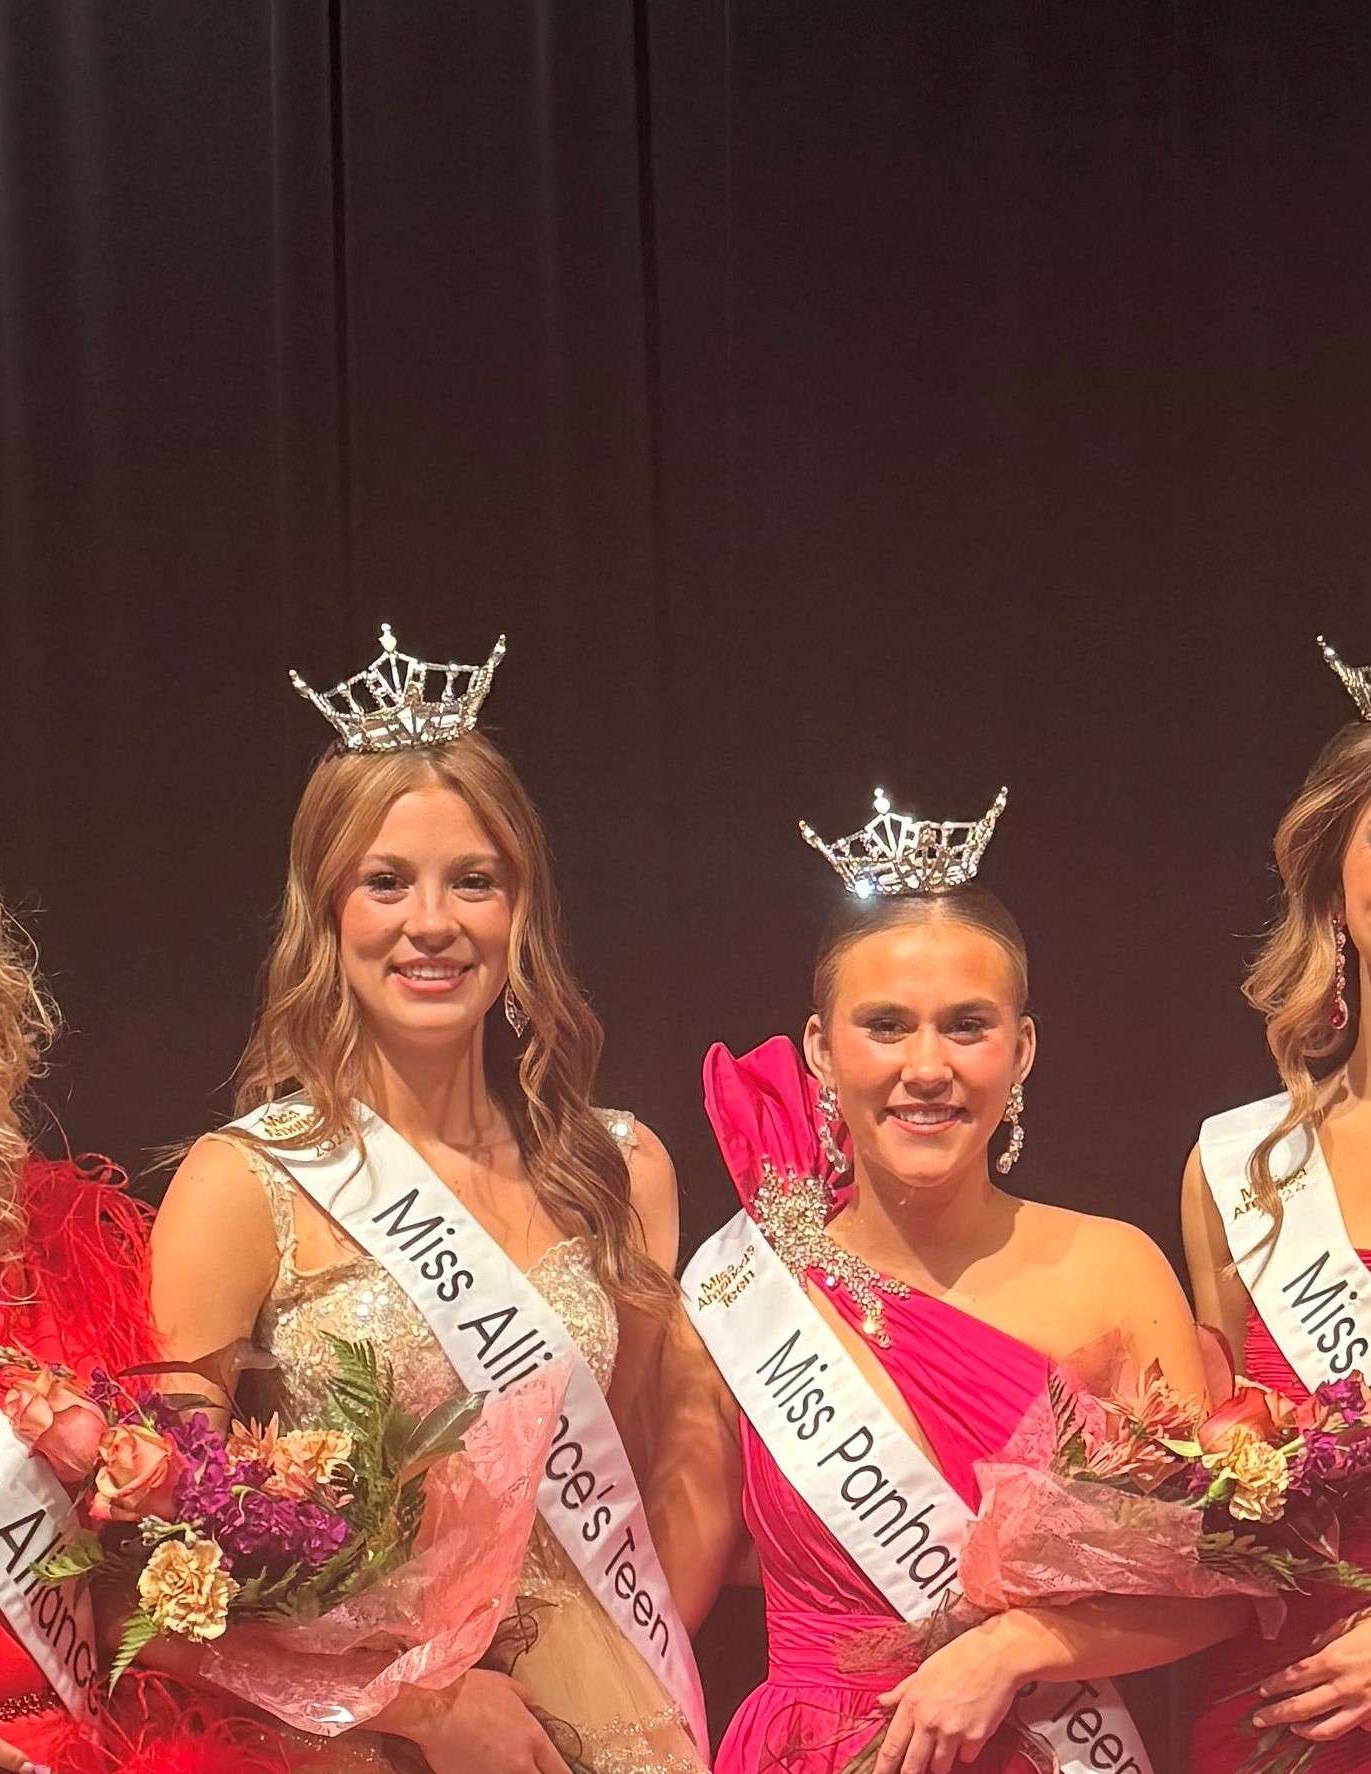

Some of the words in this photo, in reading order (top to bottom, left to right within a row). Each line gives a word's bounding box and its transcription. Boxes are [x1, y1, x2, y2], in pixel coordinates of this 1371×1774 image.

[718, 1270, 755, 1308] Teen
[1281, 1251, 1368, 1374] Miss
[371, 1189, 474, 1302] Miss
[604, 1527, 672, 1660] Teen
[756, 1329, 835, 1441] Miss
